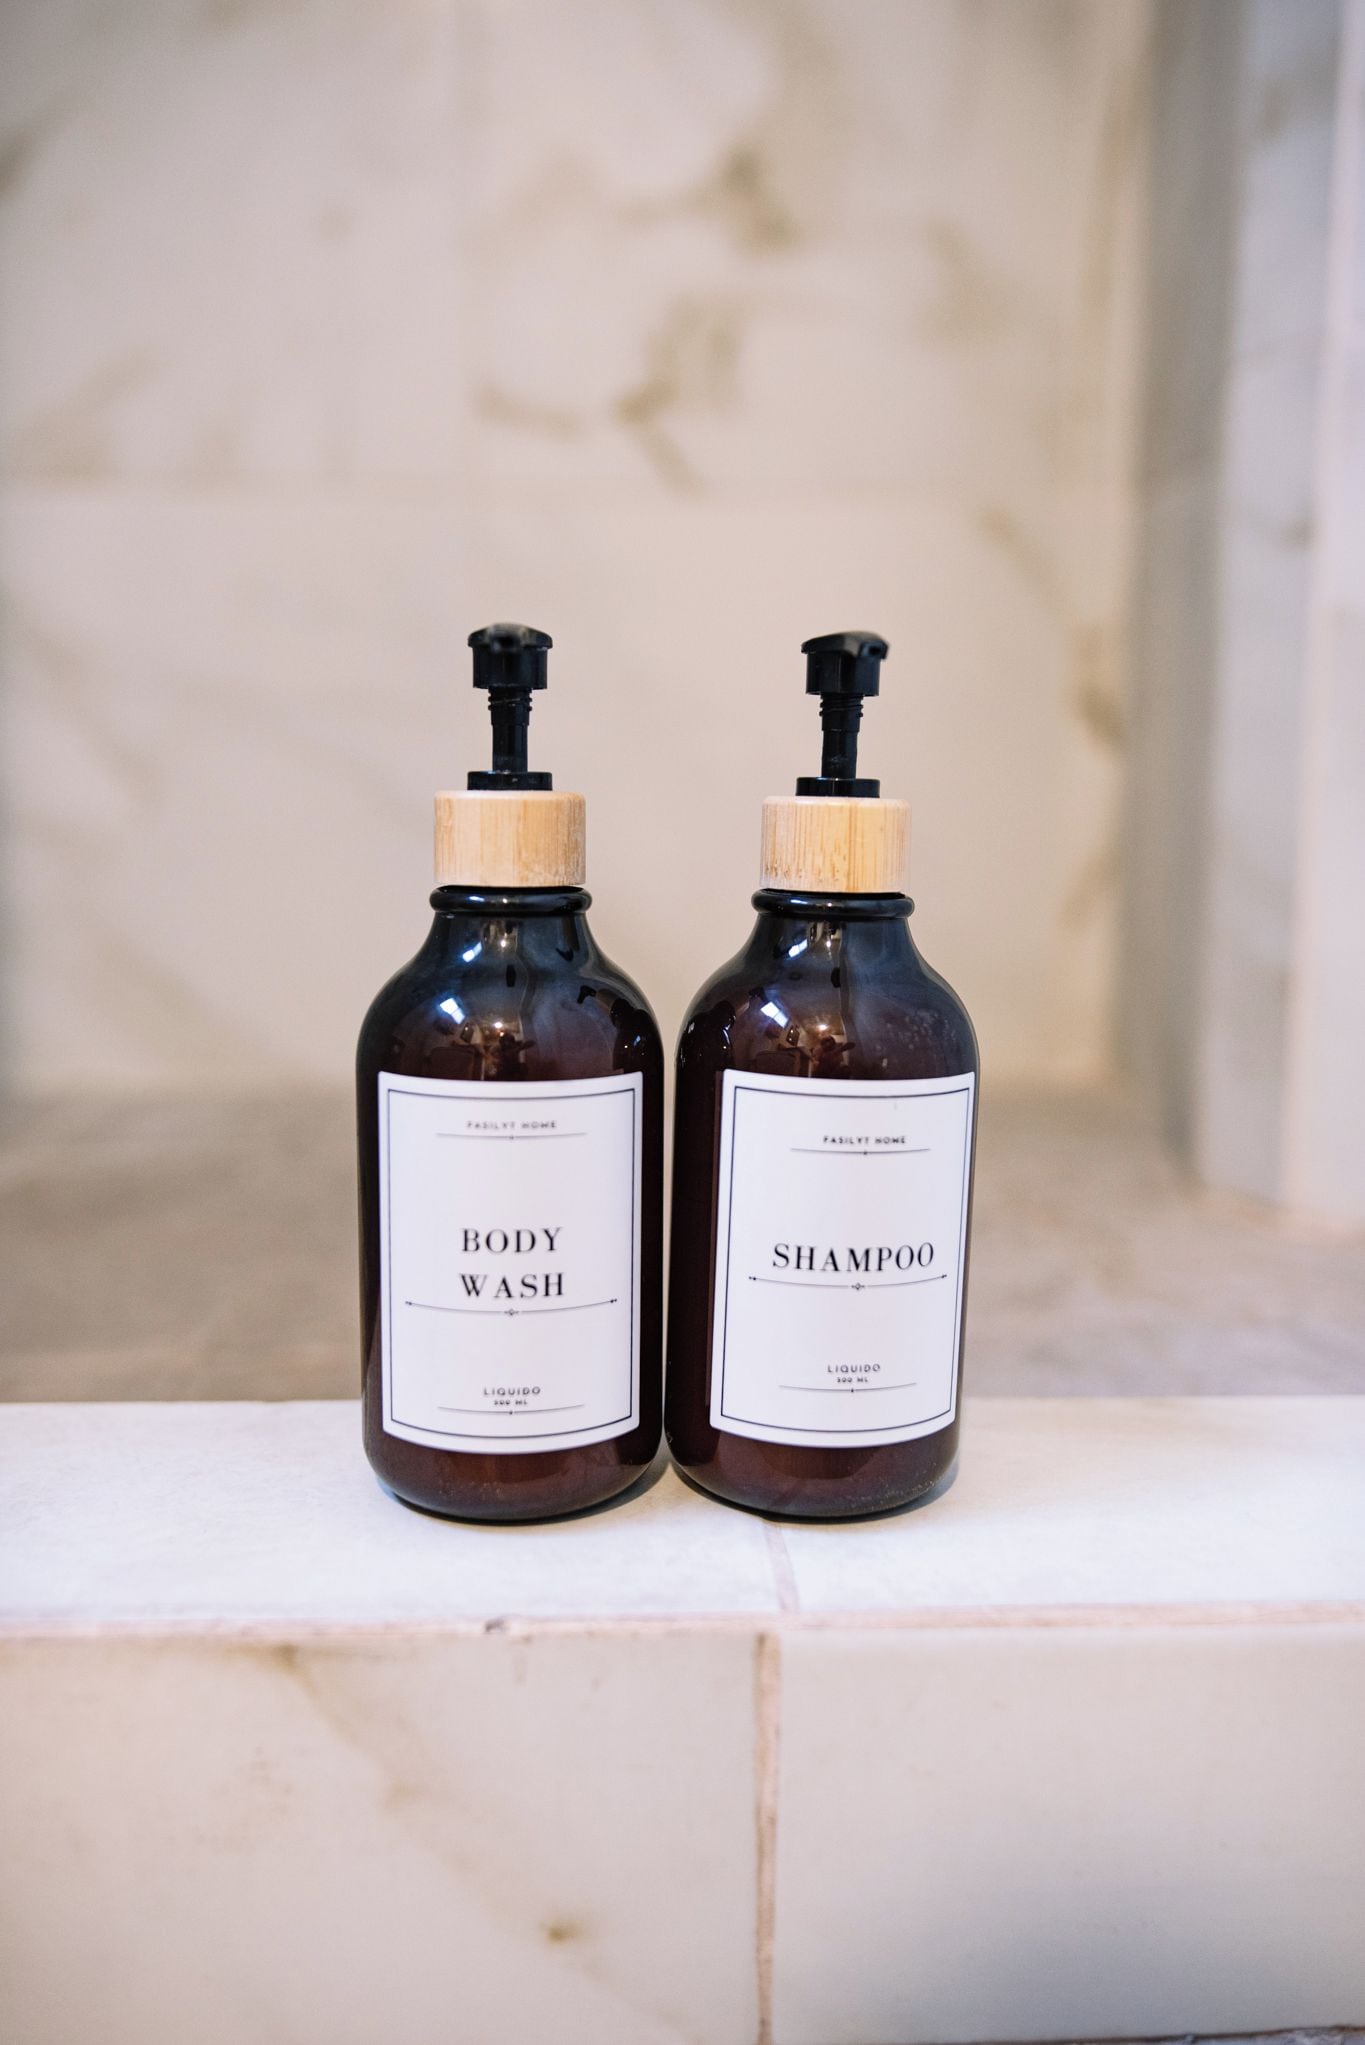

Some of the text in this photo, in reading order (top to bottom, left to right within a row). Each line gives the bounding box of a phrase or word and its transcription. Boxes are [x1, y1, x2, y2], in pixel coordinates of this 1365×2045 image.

[521, 1120, 557, 1129] HOME
[875, 1136, 906, 1145] HOME
[462, 1227, 562, 1254] BODY
[772, 1242, 935, 1273] SHAMPOO
[460, 1272, 565, 1299] WASH
[827, 1363, 881, 1374] LIQUIDO
[483, 1385, 541, 1396] LIQUIDO
